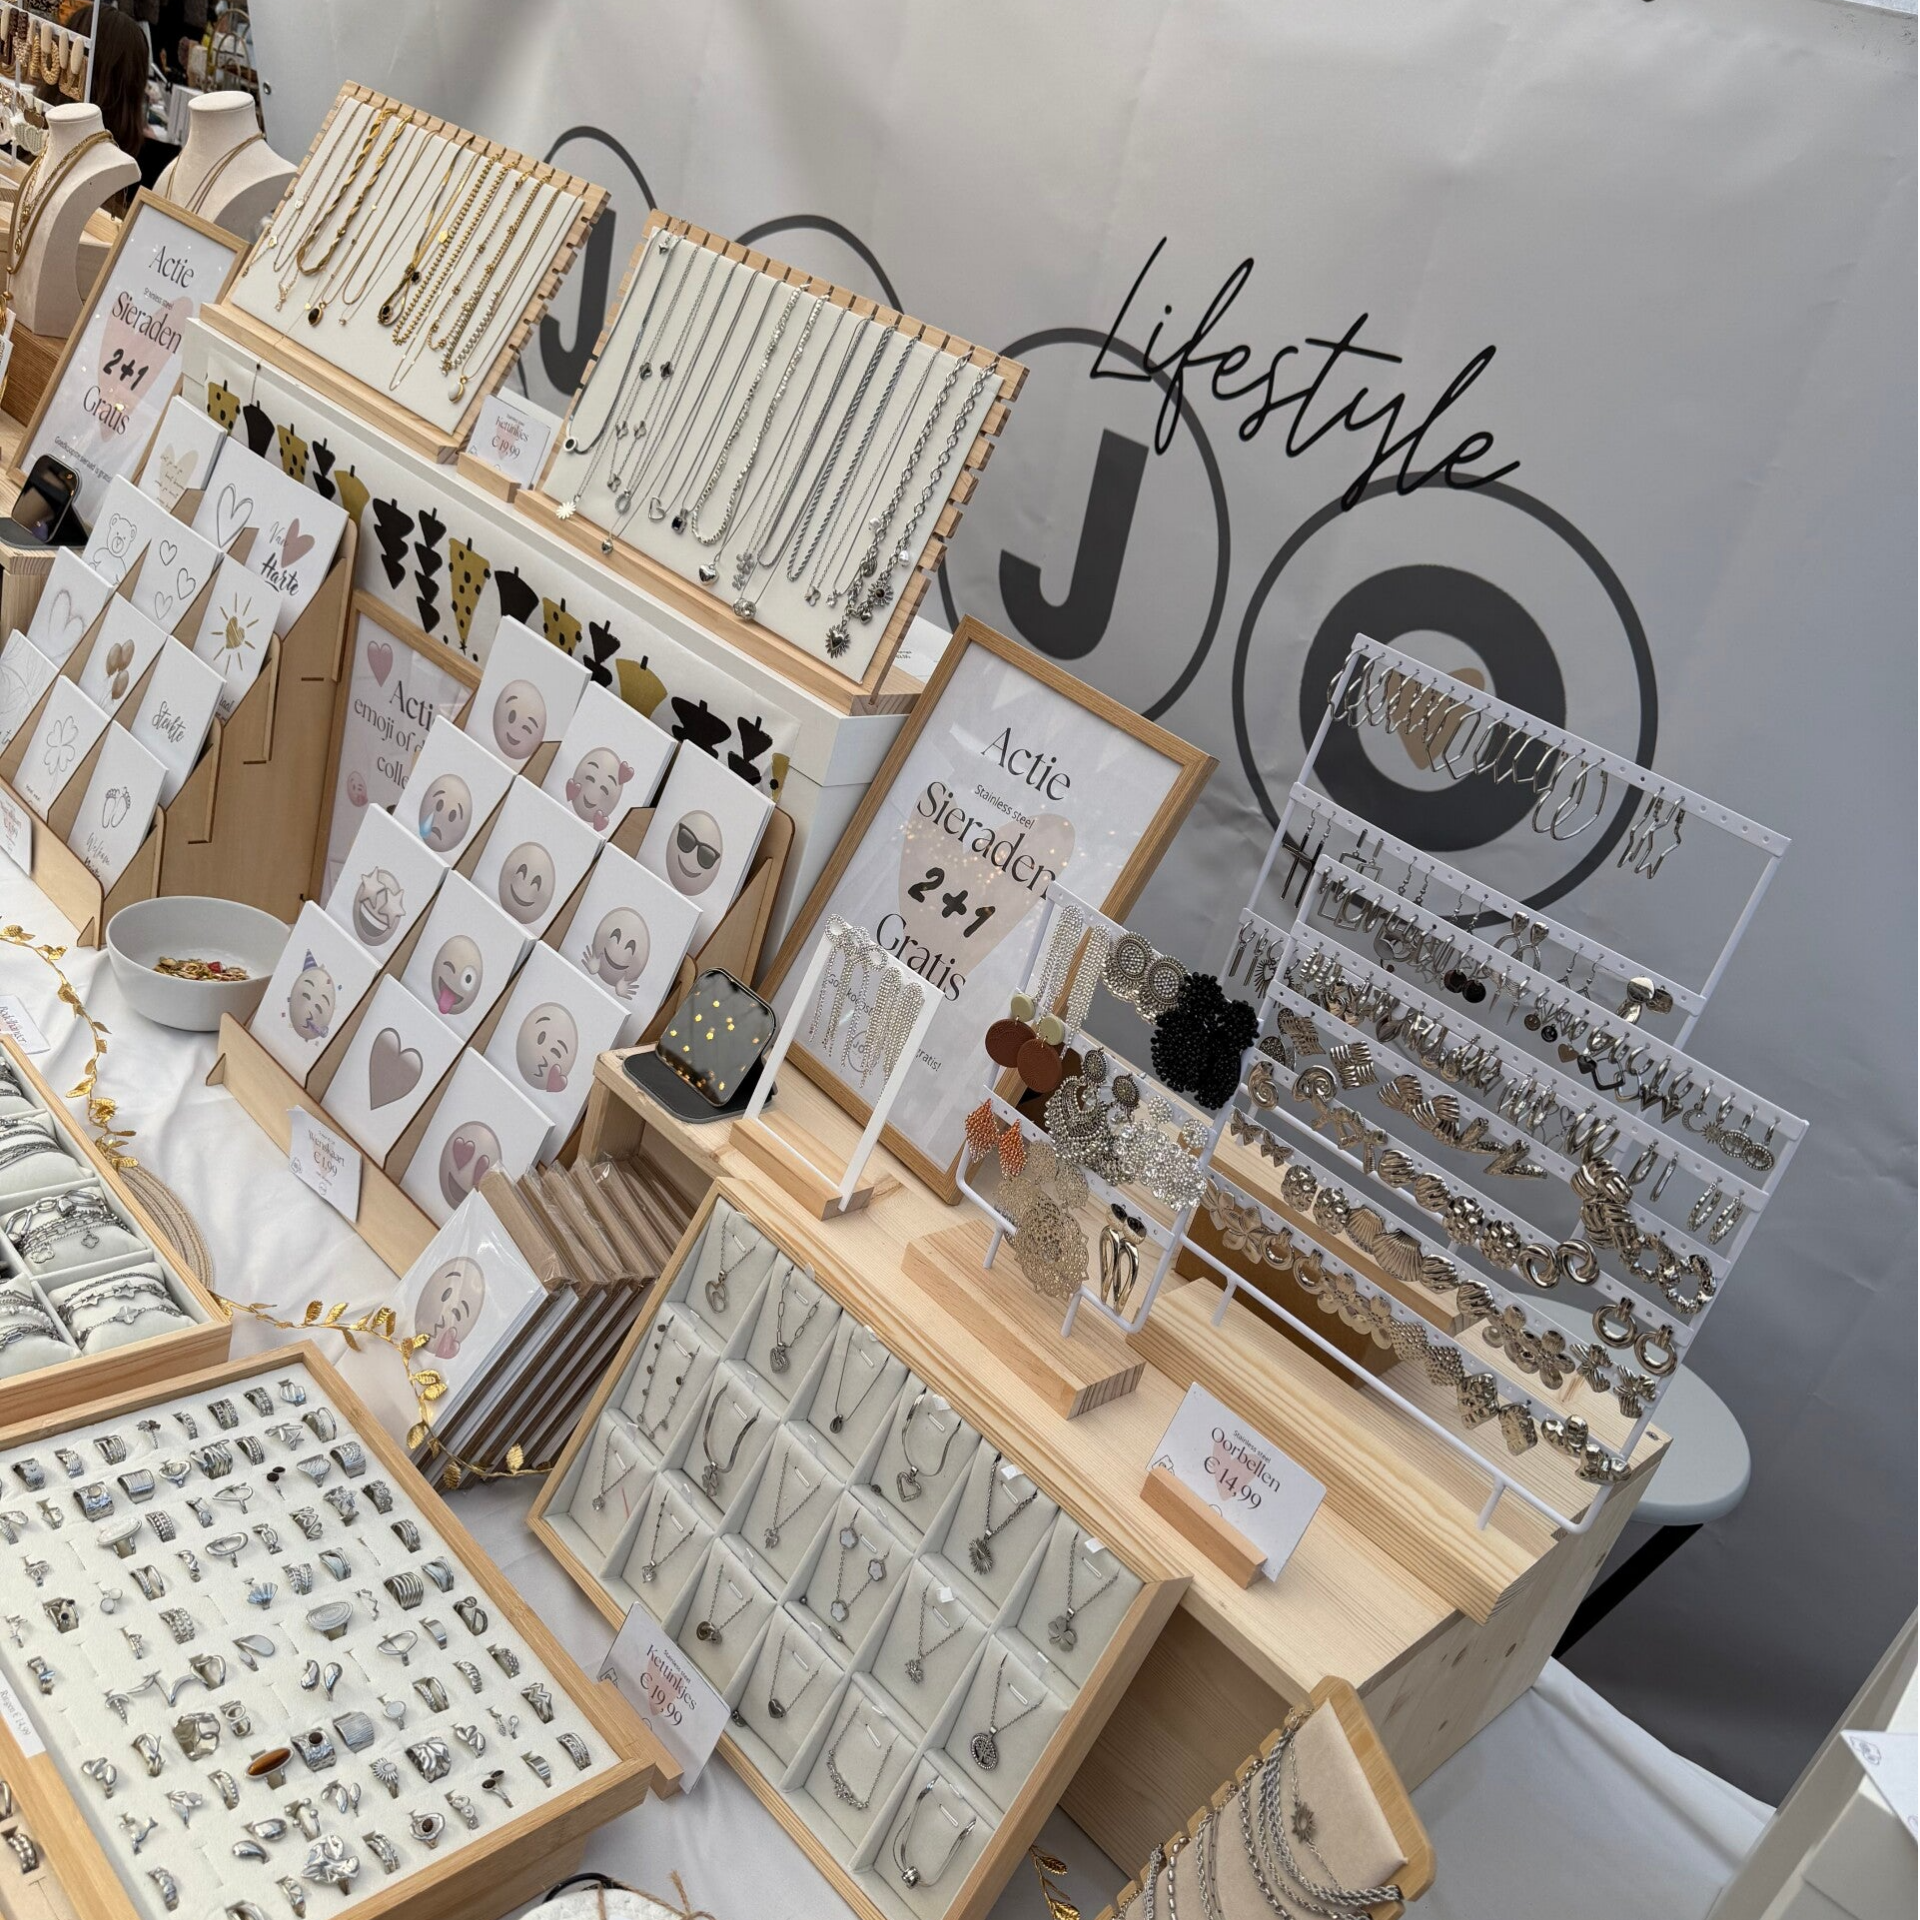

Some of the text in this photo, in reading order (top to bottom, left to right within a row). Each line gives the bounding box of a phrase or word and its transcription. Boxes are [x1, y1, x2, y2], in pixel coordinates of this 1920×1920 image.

[149, 246, 195, 288] Actie
[112, 291, 183, 354] Sieraden
[103, 348, 149, 391] 2+1
[1090, 236, 1521, 512] Lifestyle
[83, 386, 130, 435] Gratis
[261, 552, 300, 596] Harte
[152, 701, 187, 744] Sterkte
[354, 699, 395, 741] emoji
[396, 731, 416, 752] of
[389, 680, 435, 732] Acti
[377, 756, 410, 790] colle
[980, 727, 1071, 801] Actie
[974, 784, 1036, 831] Stainless steel
[917, 781, 1056, 901] Sieraden
[908, 867, 996, 938] 2+1
[876, 913, 966, 1001] Gratis
[1211, 1427, 1281, 1492] Oorbellen
[1233, 1430, 1271, 1464] Stainless steel
[1204, 1456, 1262, 1510] € 14,99
[640, 1672, 683, 1726] € 19,99
[646, 1644, 697, 1710] Kettinkjes
